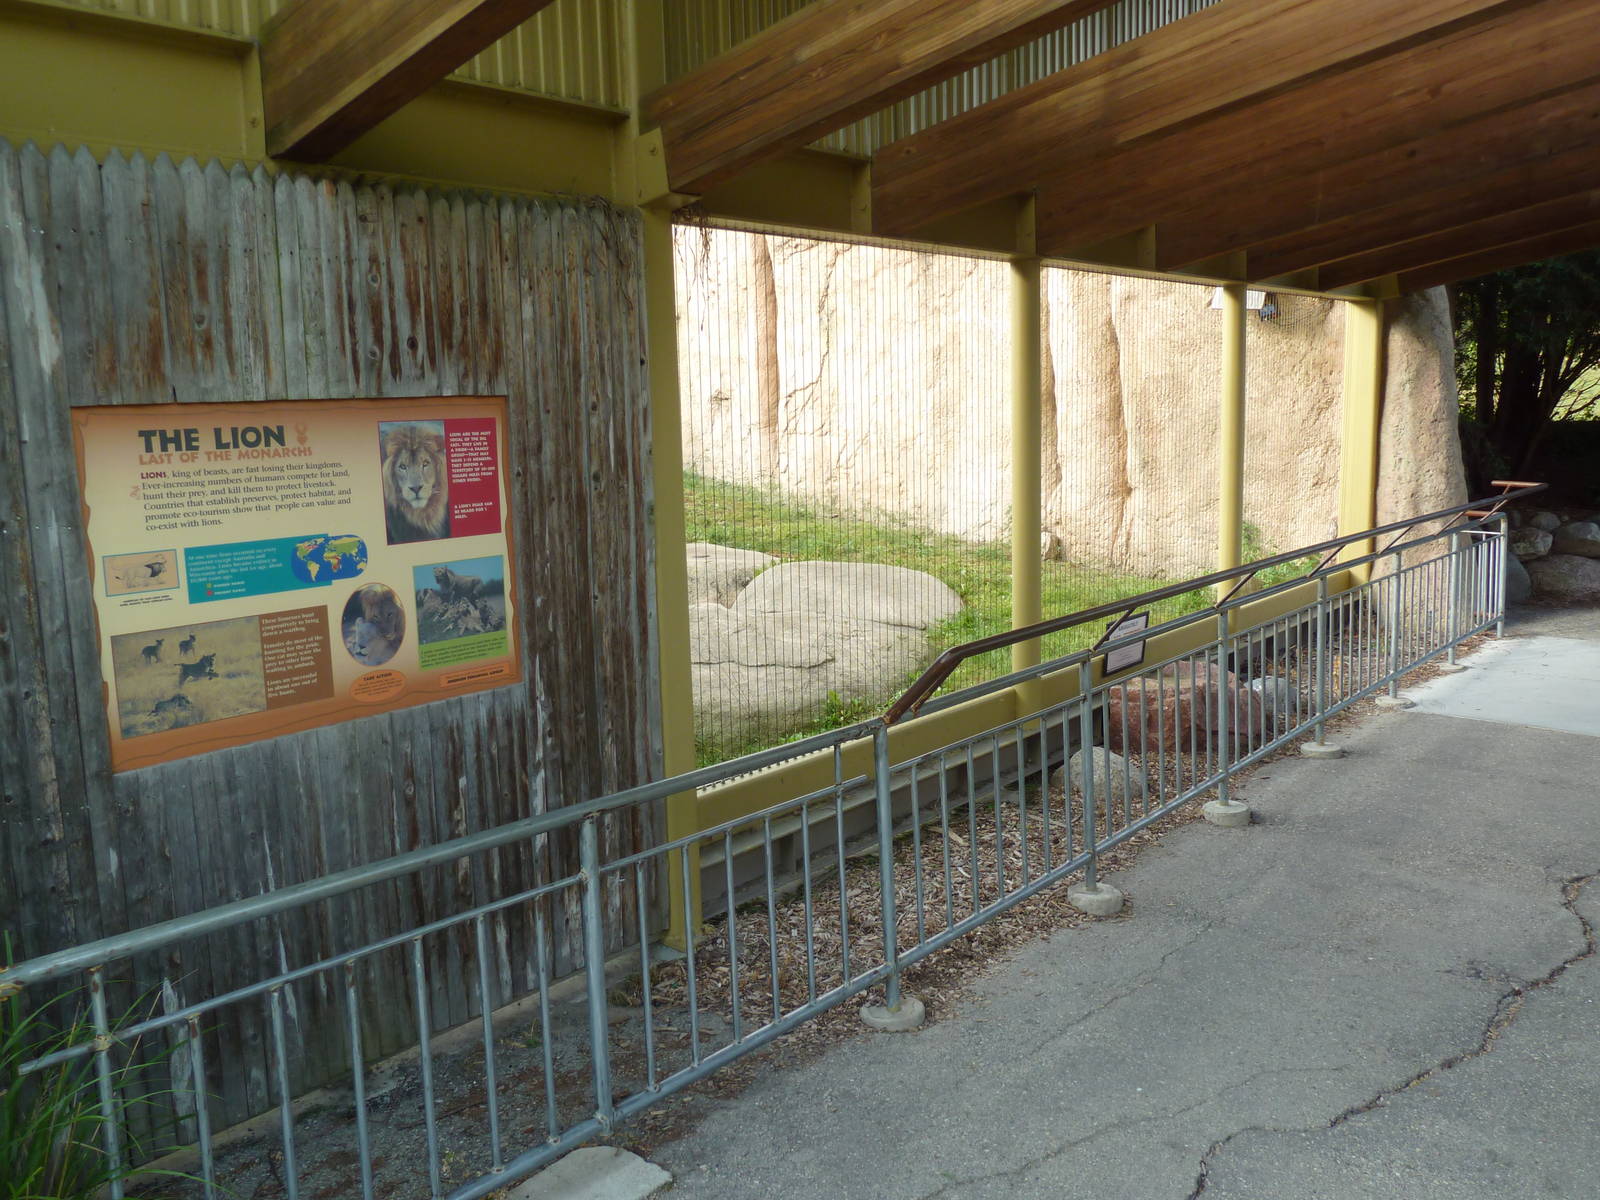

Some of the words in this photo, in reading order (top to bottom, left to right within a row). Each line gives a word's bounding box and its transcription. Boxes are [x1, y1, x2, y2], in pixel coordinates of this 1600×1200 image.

[138, 428, 200, 453] THE
[214, 425, 286, 450] LION
[139, 454, 174, 465] LAST
[180, 452, 198, 462] OF
[205, 450, 232, 462] THE
[238, 446, 312, 460] MONARCHS
[142, 480, 205, 490] Ever-increasing
[208, 476, 242, 485] numbers
[287, 472, 318, 480] compete
[172, 470, 191, 479] king
[276, 484, 301, 492] protect
[242, 495, 279, 504] preserves,
[281, 492, 306, 500] protect
[145, 513, 180, 522] promote
[183, 508, 230, 517] eco-tourism
[275, 502, 299, 511] people
